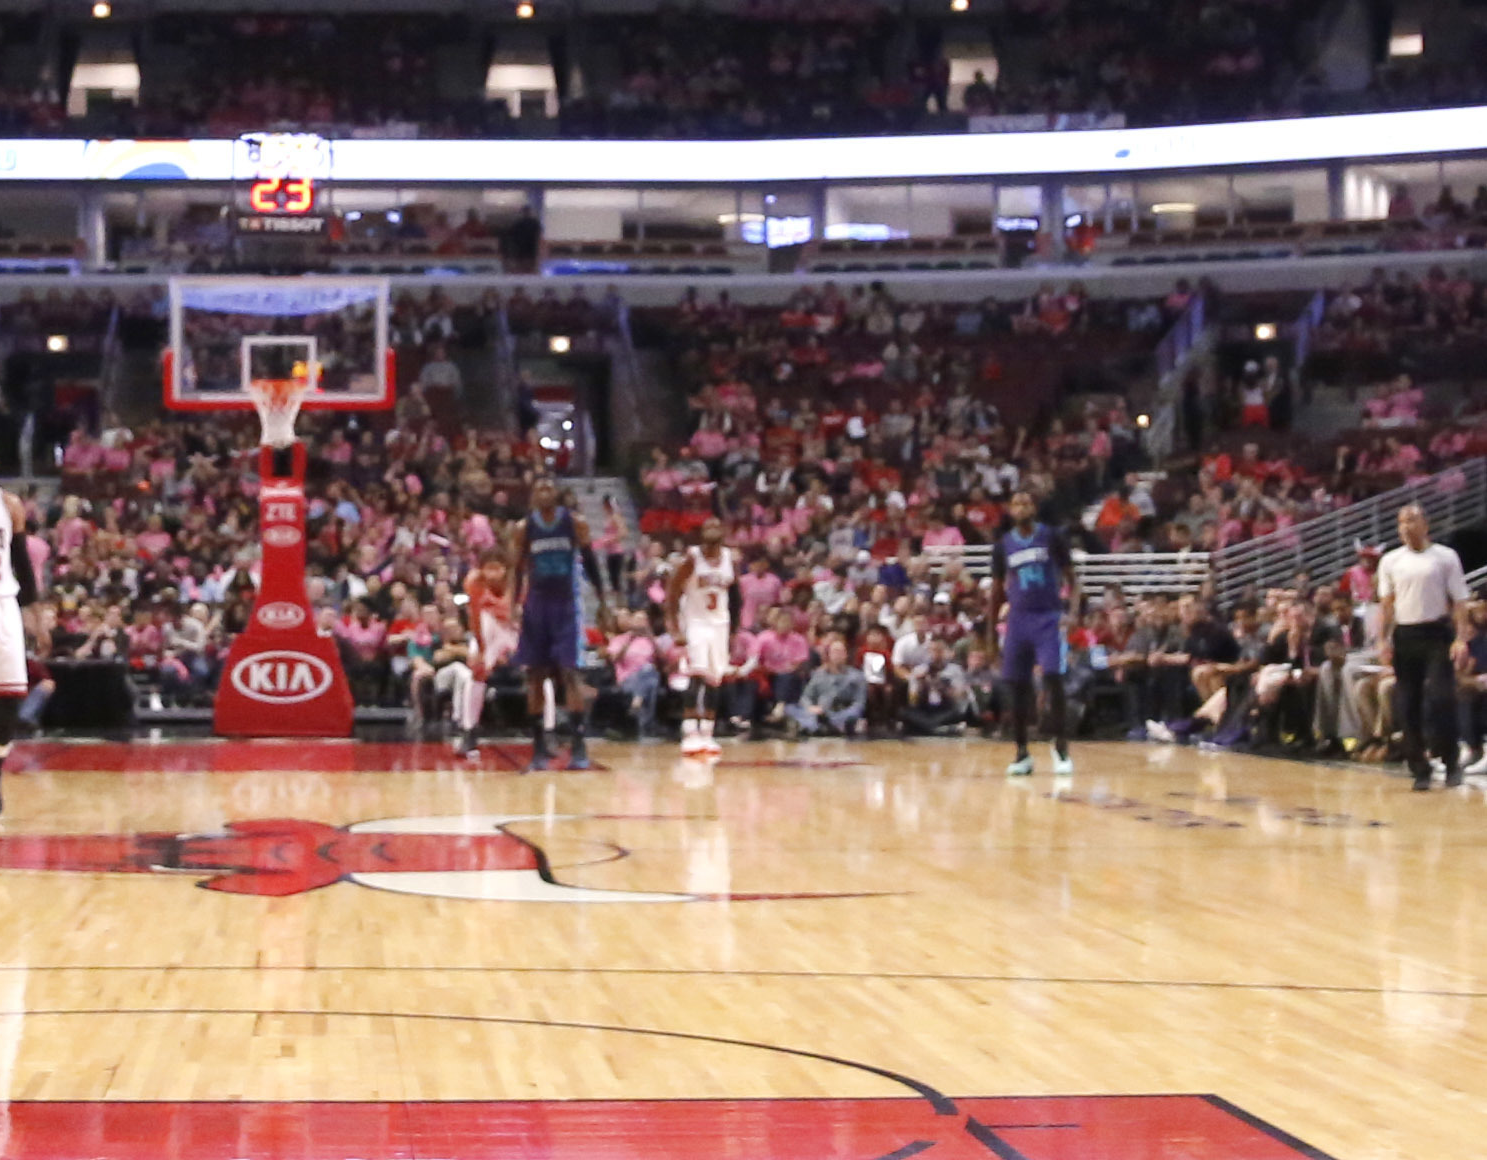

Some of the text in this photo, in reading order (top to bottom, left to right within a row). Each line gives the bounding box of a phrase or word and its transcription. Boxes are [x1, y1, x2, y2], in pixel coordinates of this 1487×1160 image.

[251, 176, 314, 213] 23
[264, 217, 324, 232] TISSOT
[249, 662, 316, 691] KIA
